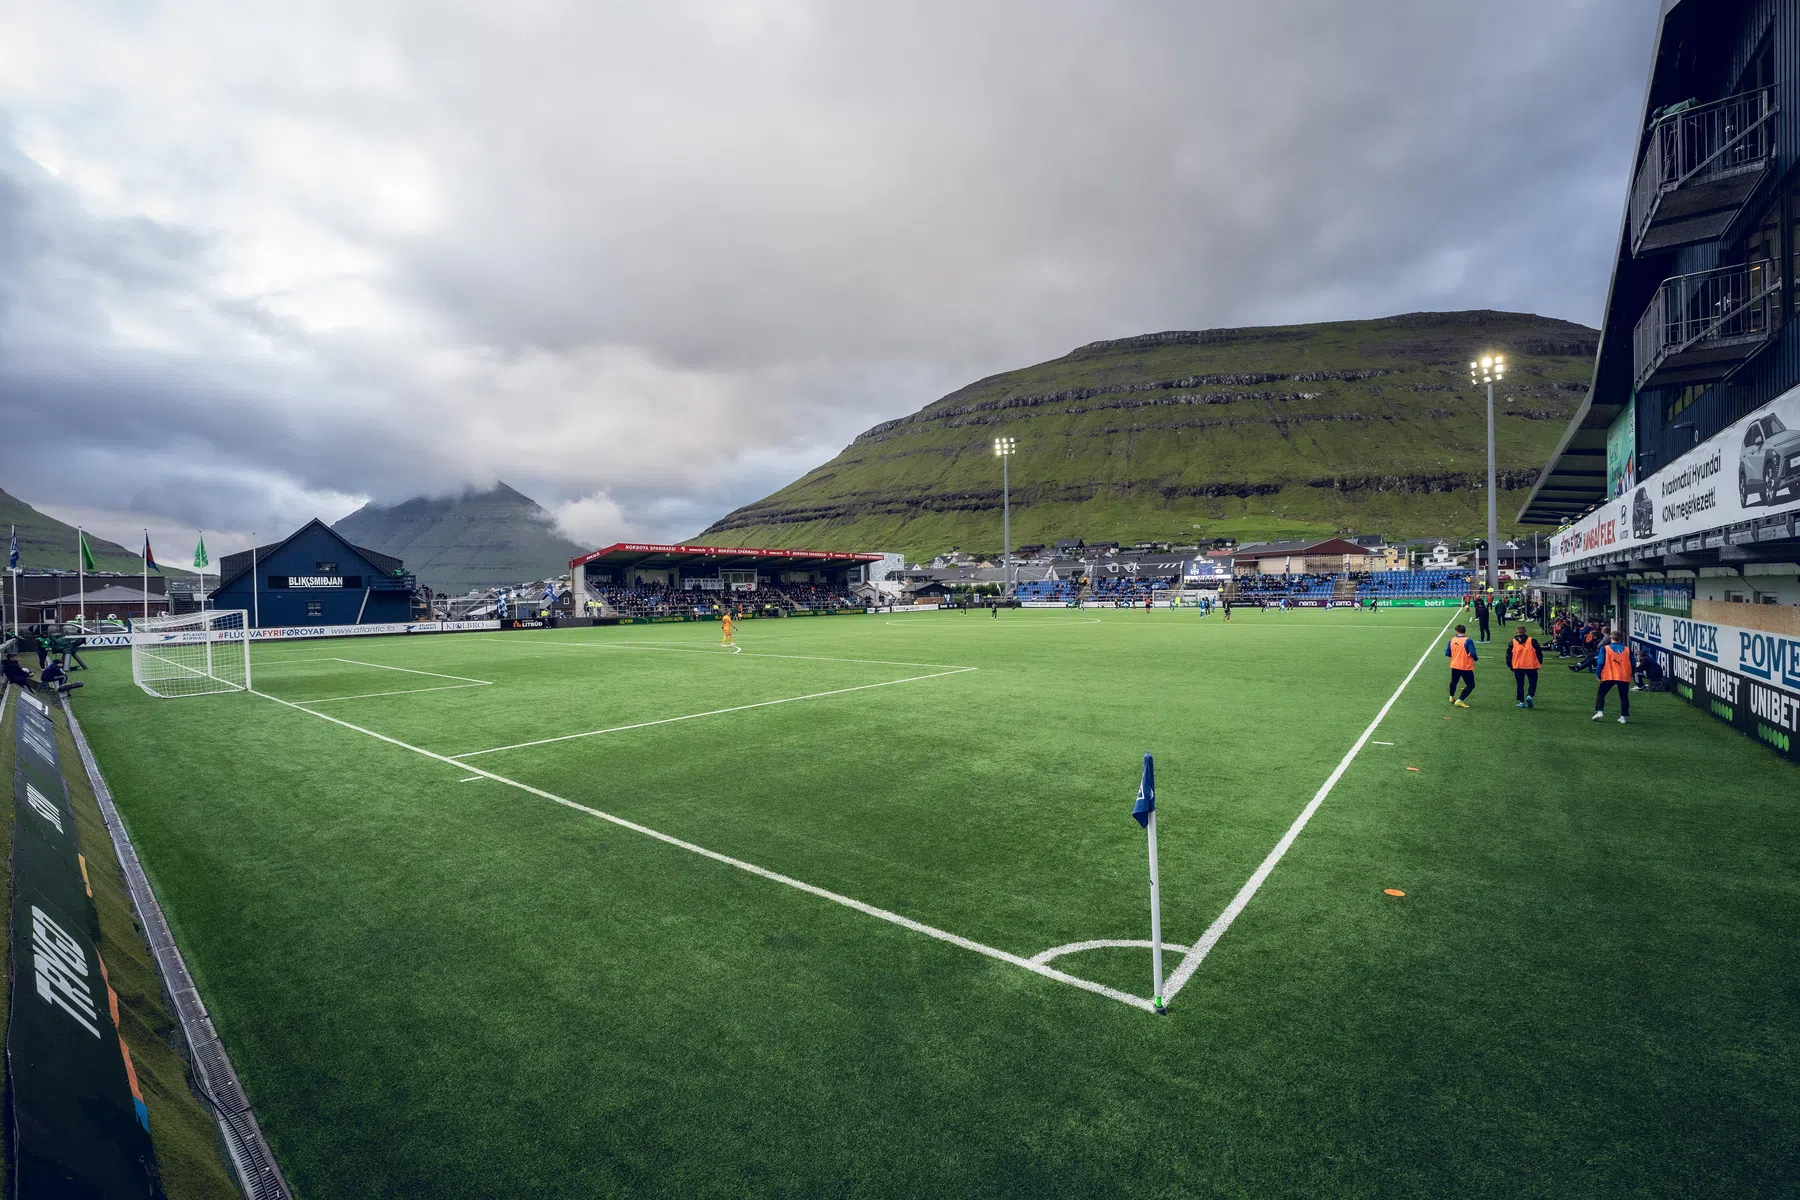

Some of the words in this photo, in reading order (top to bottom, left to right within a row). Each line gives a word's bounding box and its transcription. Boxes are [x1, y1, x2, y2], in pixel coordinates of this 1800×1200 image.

[1692, 448, 1721, 486] Hyundai
[331, 625, 395, 635] www.atlantic.fo
[1634, 612, 1662, 641] POMEK
[1672, 619, 1719, 656] POMEK
[1673, 655, 1698, 686] UNIBET
[1705, 666, 1740, 705] UNIBET
[1750, 683, 1800, 732] UNIBET
[32, 904, 101, 1041] TRYGD
